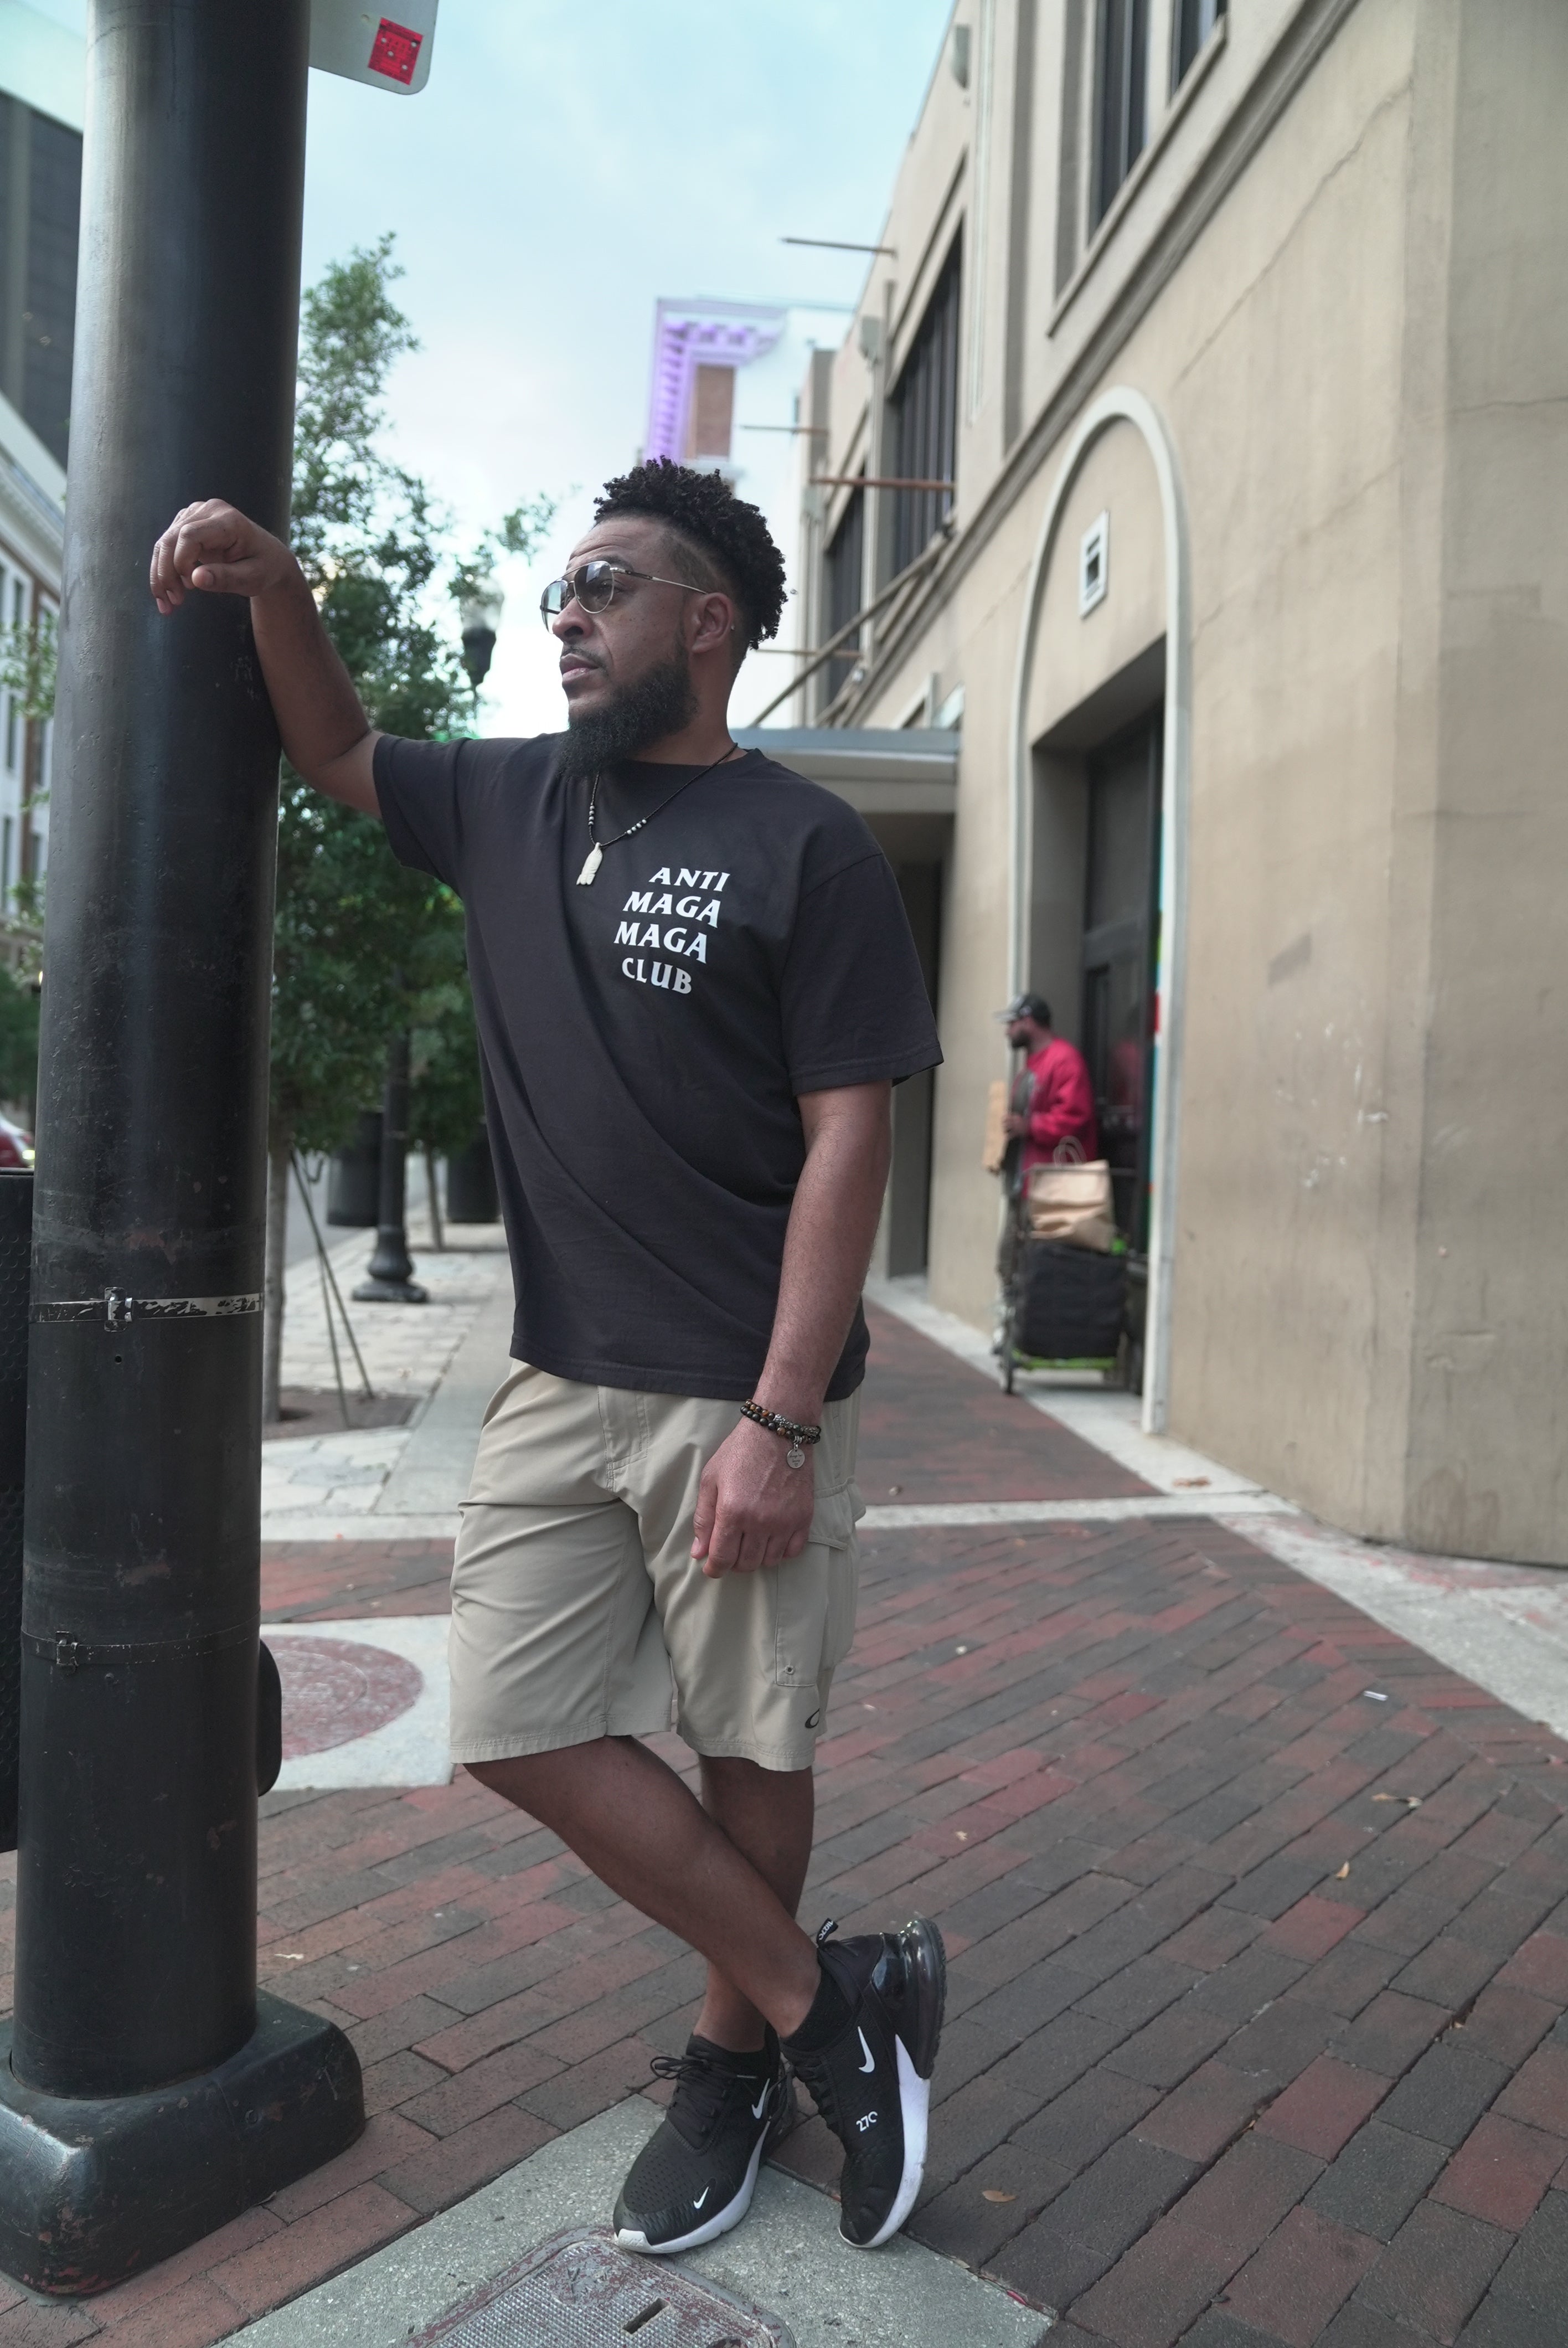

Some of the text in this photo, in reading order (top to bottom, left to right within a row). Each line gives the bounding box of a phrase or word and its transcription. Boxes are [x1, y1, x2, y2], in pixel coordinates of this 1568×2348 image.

[648, 867, 731, 892] ANTI
[622, 891, 721, 929] MAGA
[613, 921, 707, 964] MAGA
[622, 957, 692, 994] CLUB
